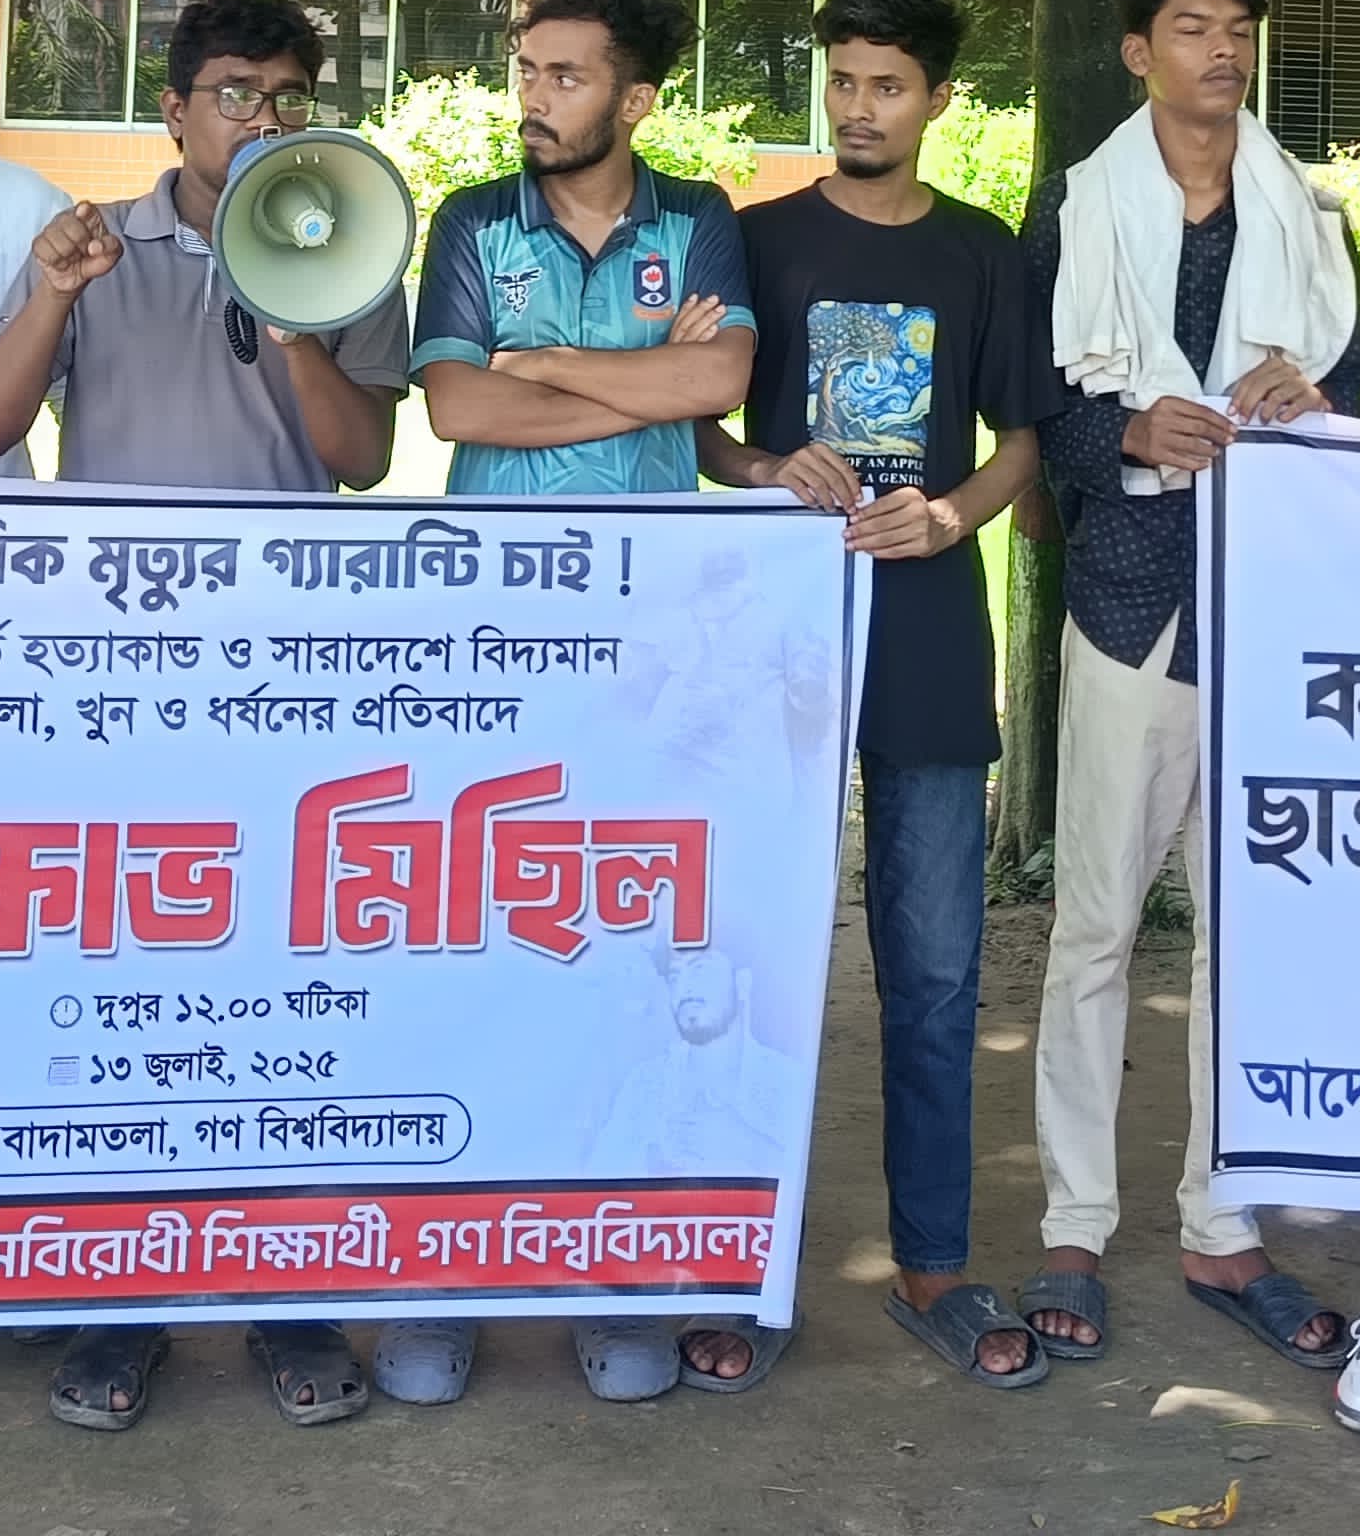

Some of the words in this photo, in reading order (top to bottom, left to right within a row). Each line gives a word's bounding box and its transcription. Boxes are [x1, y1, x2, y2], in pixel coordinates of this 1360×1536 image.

[865, 473, 874, 483] A
[879, 473, 924, 487] GENIUS
[867, 457, 886, 468] AN
[89, 537, 242, 615] মৃত্যুর
[501, 528, 594, 594] চাই
[221, 639, 253, 670] ও
[268, 633, 457, 675] সারাদেশে
[468, 625, 624, 675] বিদ্যমান
[77, 693, 140, 746] খুন
[156, 699, 188, 731] ও
[353, 684, 524, 735] প্রতিবাদে
[289, 763, 710, 955] মিছিল
[94, 992, 164, 1033] দুপুর
[177, 994, 273, 1026] ১২.০০
[283, 981, 371, 1020] ঘটিকা
[91, 1055, 133, 1086] ১৩
[143, 1042, 237, 1090] জুলাই,
[251, 1051, 339, 1084] ২০২৫
[1, 1117, 179, 1163] বাদামতলা,
[195, 1114, 247, 1154] গণ
[257, 1104, 449, 1152] বিশ্ববিদ্যালয়
[419, 1221, 493, 1266] গণ
